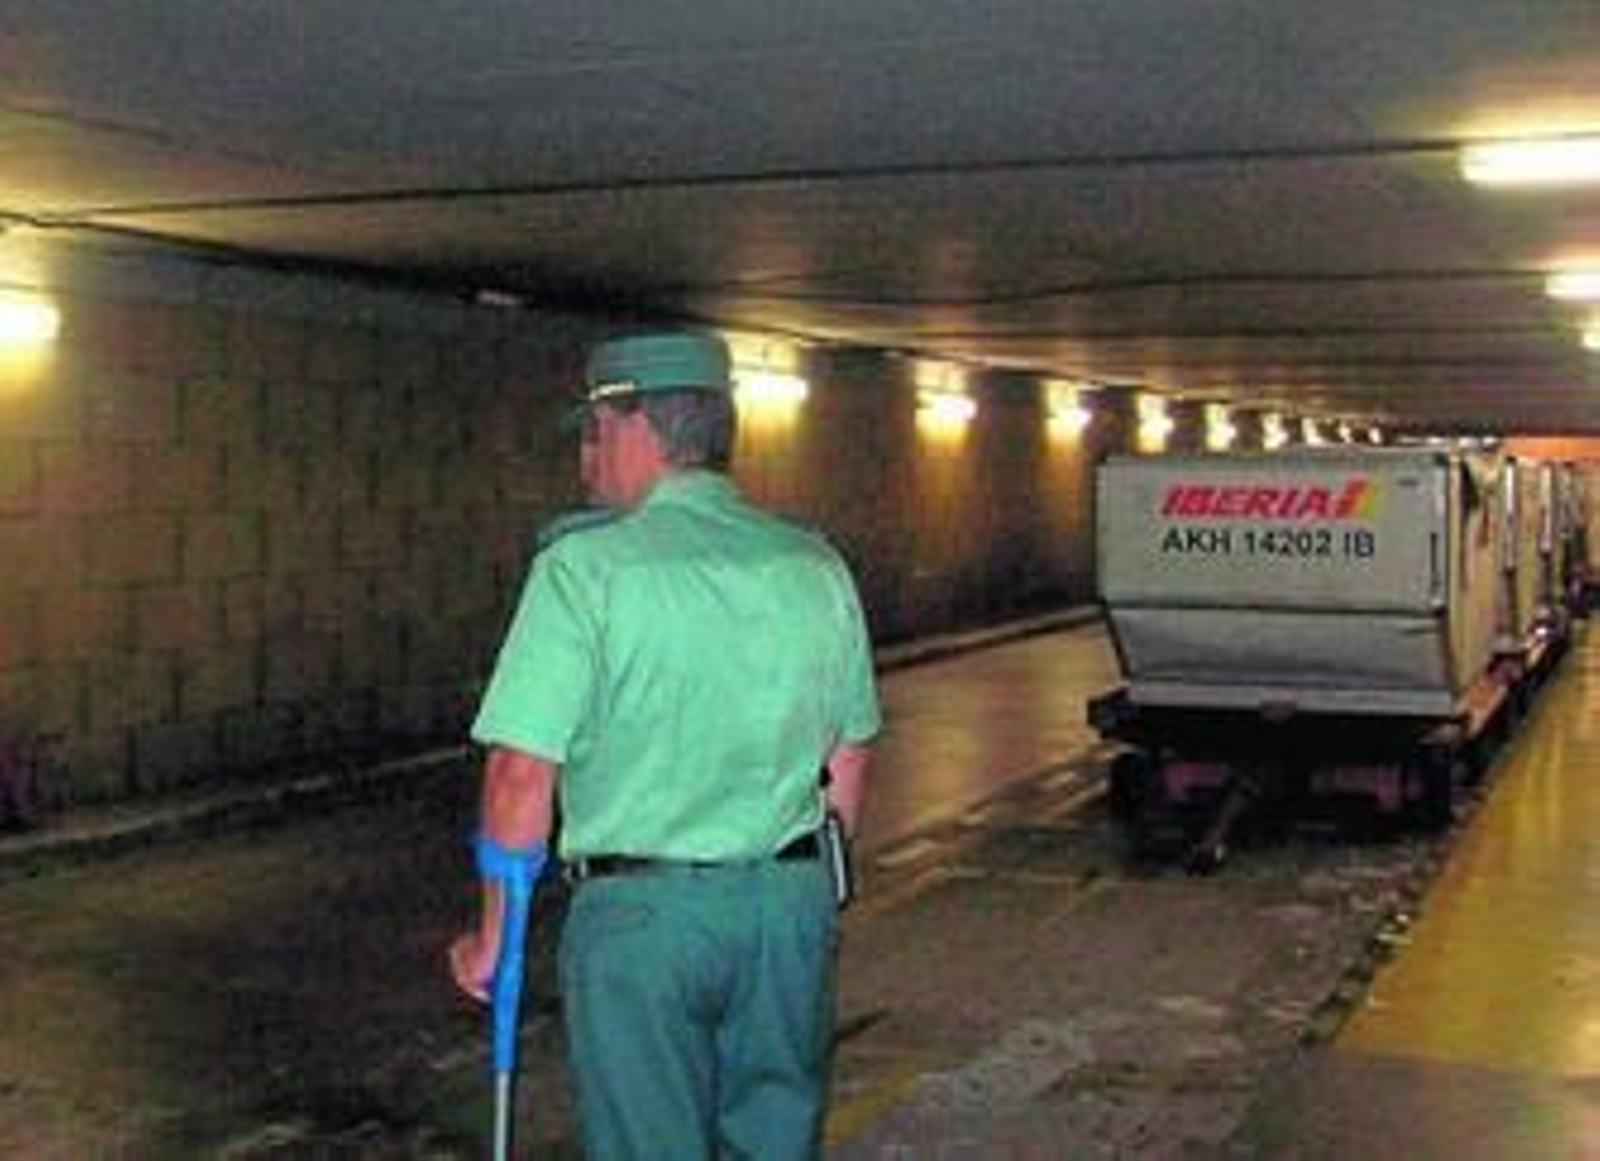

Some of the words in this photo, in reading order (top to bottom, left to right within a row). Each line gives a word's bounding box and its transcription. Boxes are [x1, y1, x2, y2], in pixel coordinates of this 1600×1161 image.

[1161, 485, 1332, 517] IBERIA
[1162, 528, 1231, 554] AKH
[1243, 529, 1332, 556] 14202
[1343, 530, 1376, 557] IB
